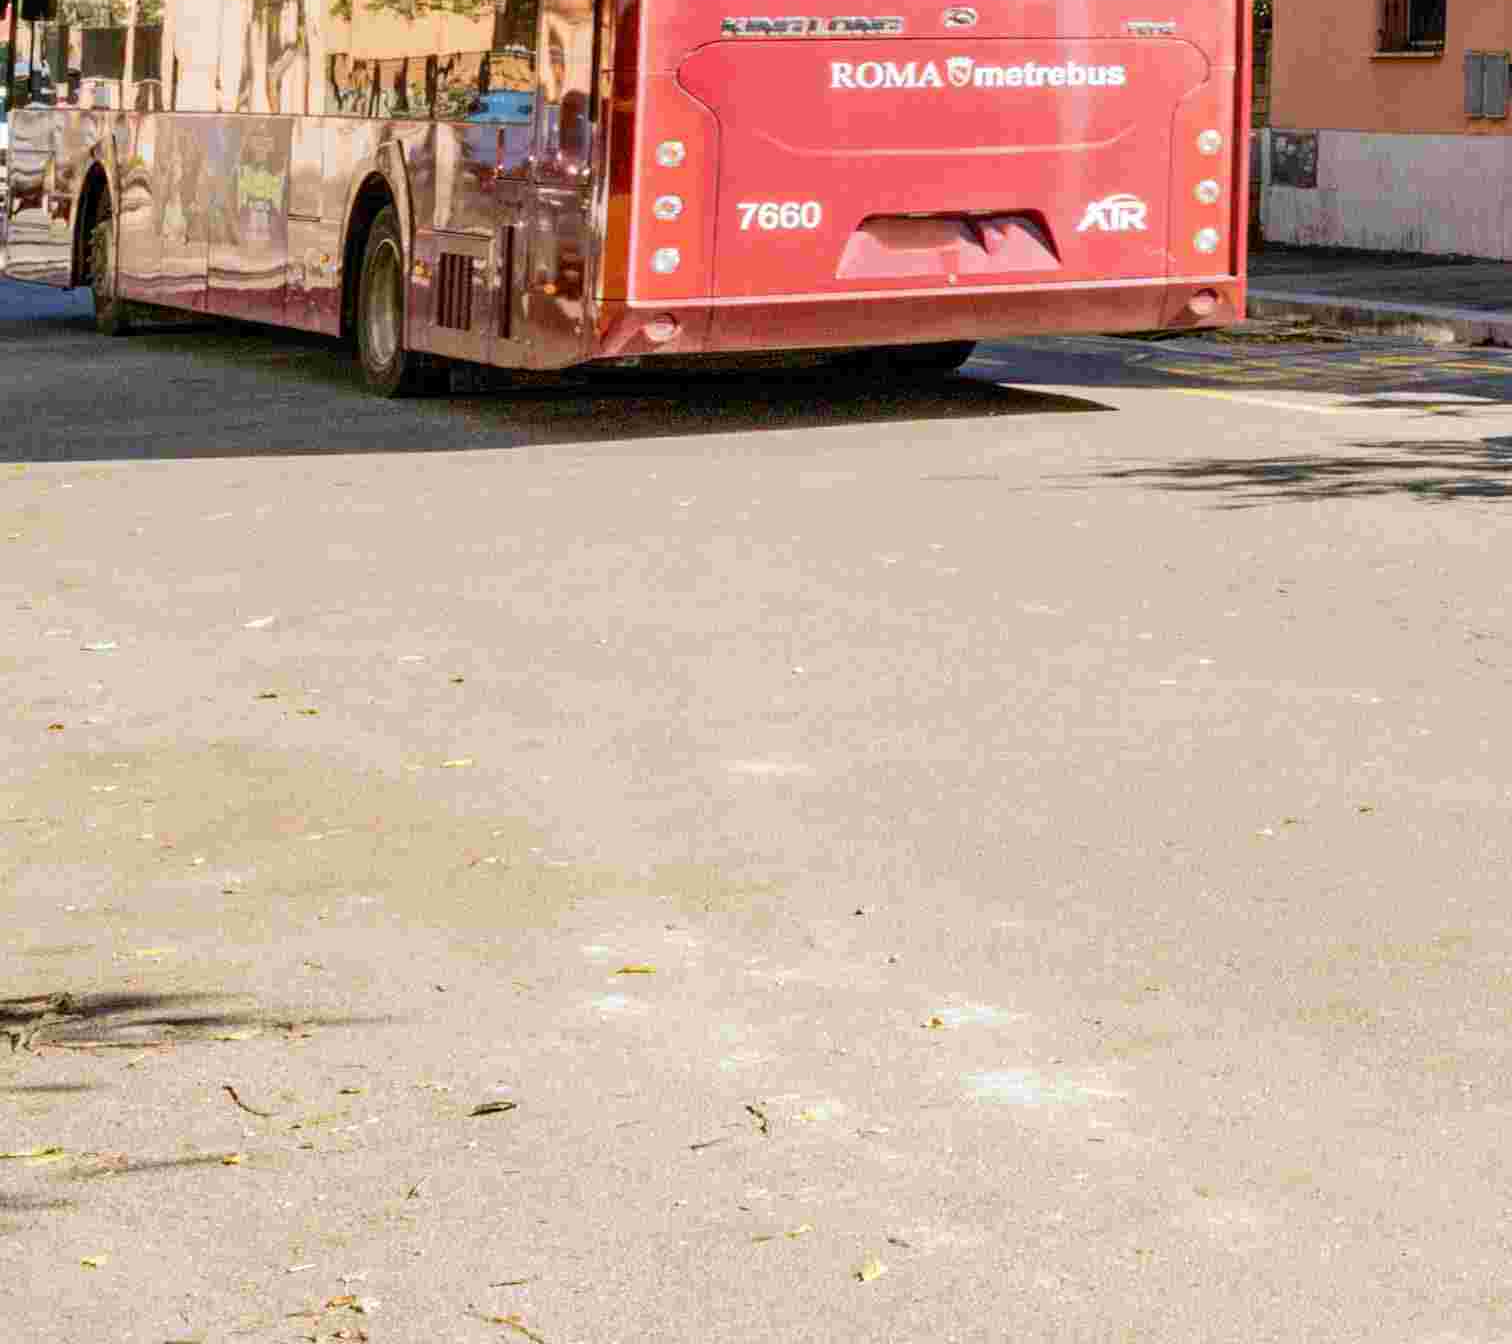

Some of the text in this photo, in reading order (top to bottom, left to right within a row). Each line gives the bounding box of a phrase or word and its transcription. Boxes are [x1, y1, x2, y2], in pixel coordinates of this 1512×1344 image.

[829, 60, 1126, 88] ROMA metrebus
[735, 201, 822, 230] 7660
